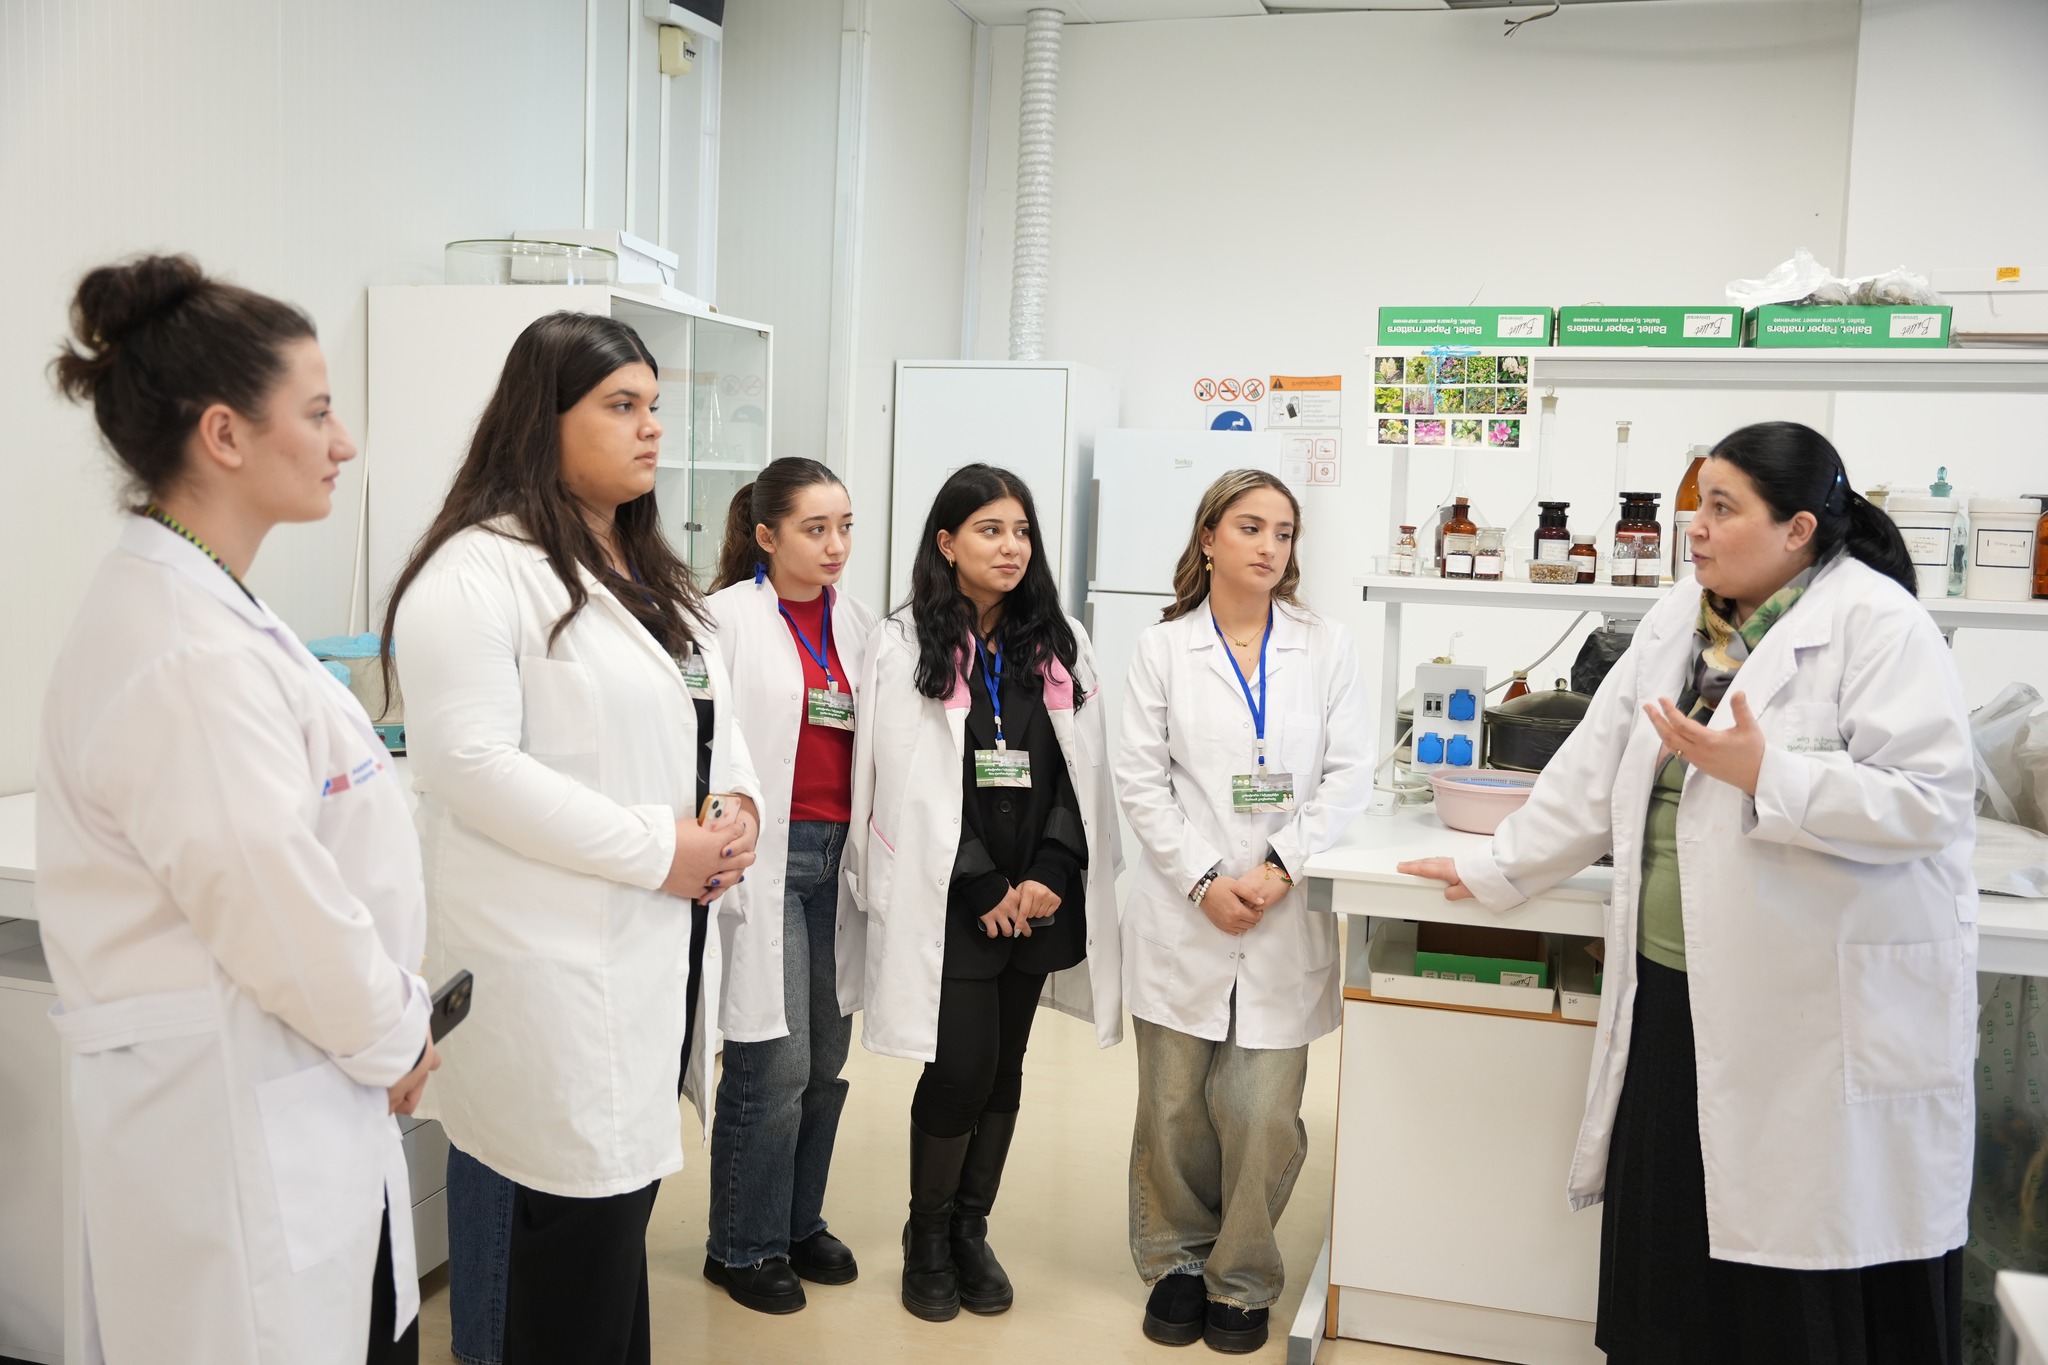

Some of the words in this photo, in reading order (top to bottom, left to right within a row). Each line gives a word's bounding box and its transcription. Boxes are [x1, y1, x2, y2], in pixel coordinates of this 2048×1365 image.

[1387, 326, 1421, 334] matters
[1424, 324, 1450, 334] Paper
[1453, 326, 1482, 334] Ballet.
[1508, 318, 1538, 336] Ballet
[1567, 325, 1603, 333] matters
[1607, 323, 1634, 333] Paper
[1637, 325, 1666, 334] Ballet.
[1695, 317, 1726, 336] Ballet
[1766, 325, 1804, 334] matters
[1807, 323, 1837, 334] Paper
[1840, 325, 1872, 334] Ballet.
[1900, 317, 1934, 336] Ballet
[2028, 984, 2039, 1010] LED
[2005, 1001, 2014, 1026] LED
[2027, 1031, 2038, 1056] LED
[2004, 1048, 2014, 1073] LED
[1984, 1065, 1993, 1091] LED
[2028, 1079, 2040, 1104] LED
[2004, 1096, 2014, 1121] LED
[1983, 1113, 1992, 1138] LED
